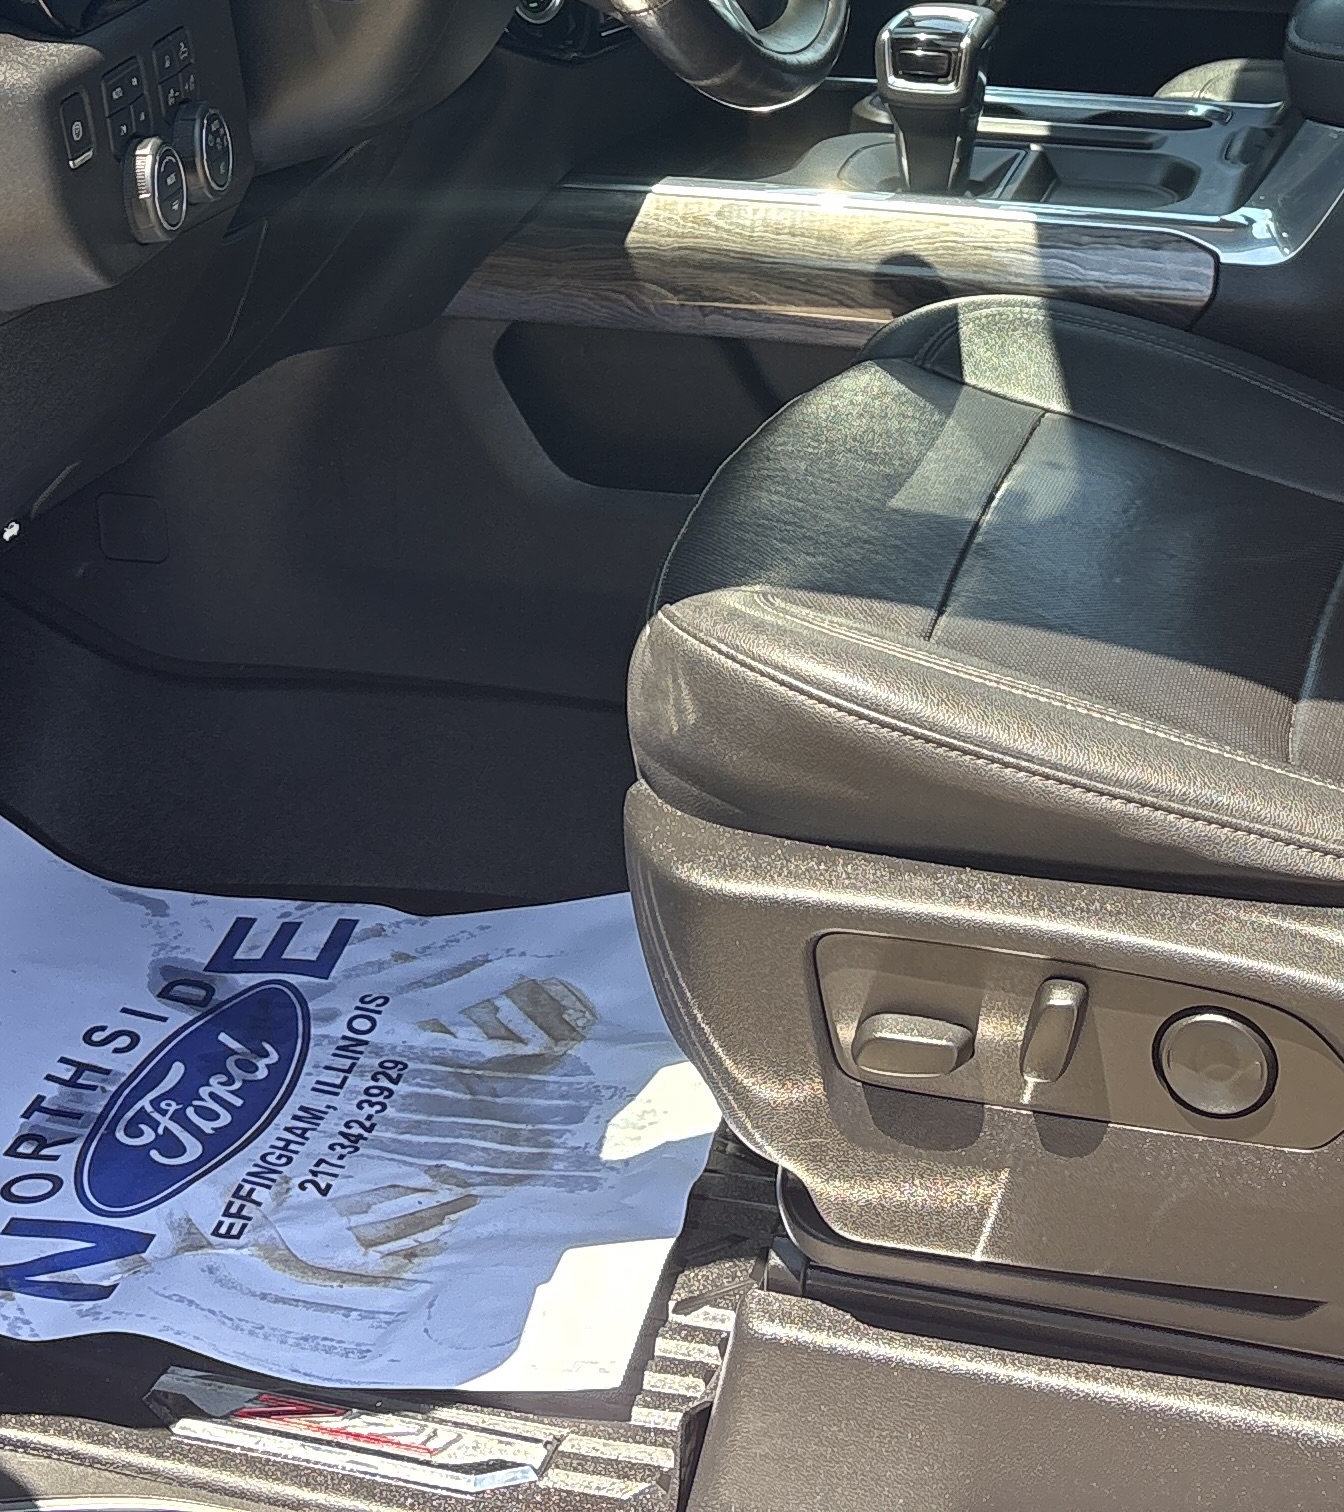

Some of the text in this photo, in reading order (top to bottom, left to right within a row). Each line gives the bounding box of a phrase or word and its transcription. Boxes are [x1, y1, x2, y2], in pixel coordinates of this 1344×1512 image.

[115, 1031, 280, 1166] Ford
[211, 992, 391, 1241] EFFINGHAM, ILLINOIS
[298, 1058, 410, 1198] 217-342-3929
